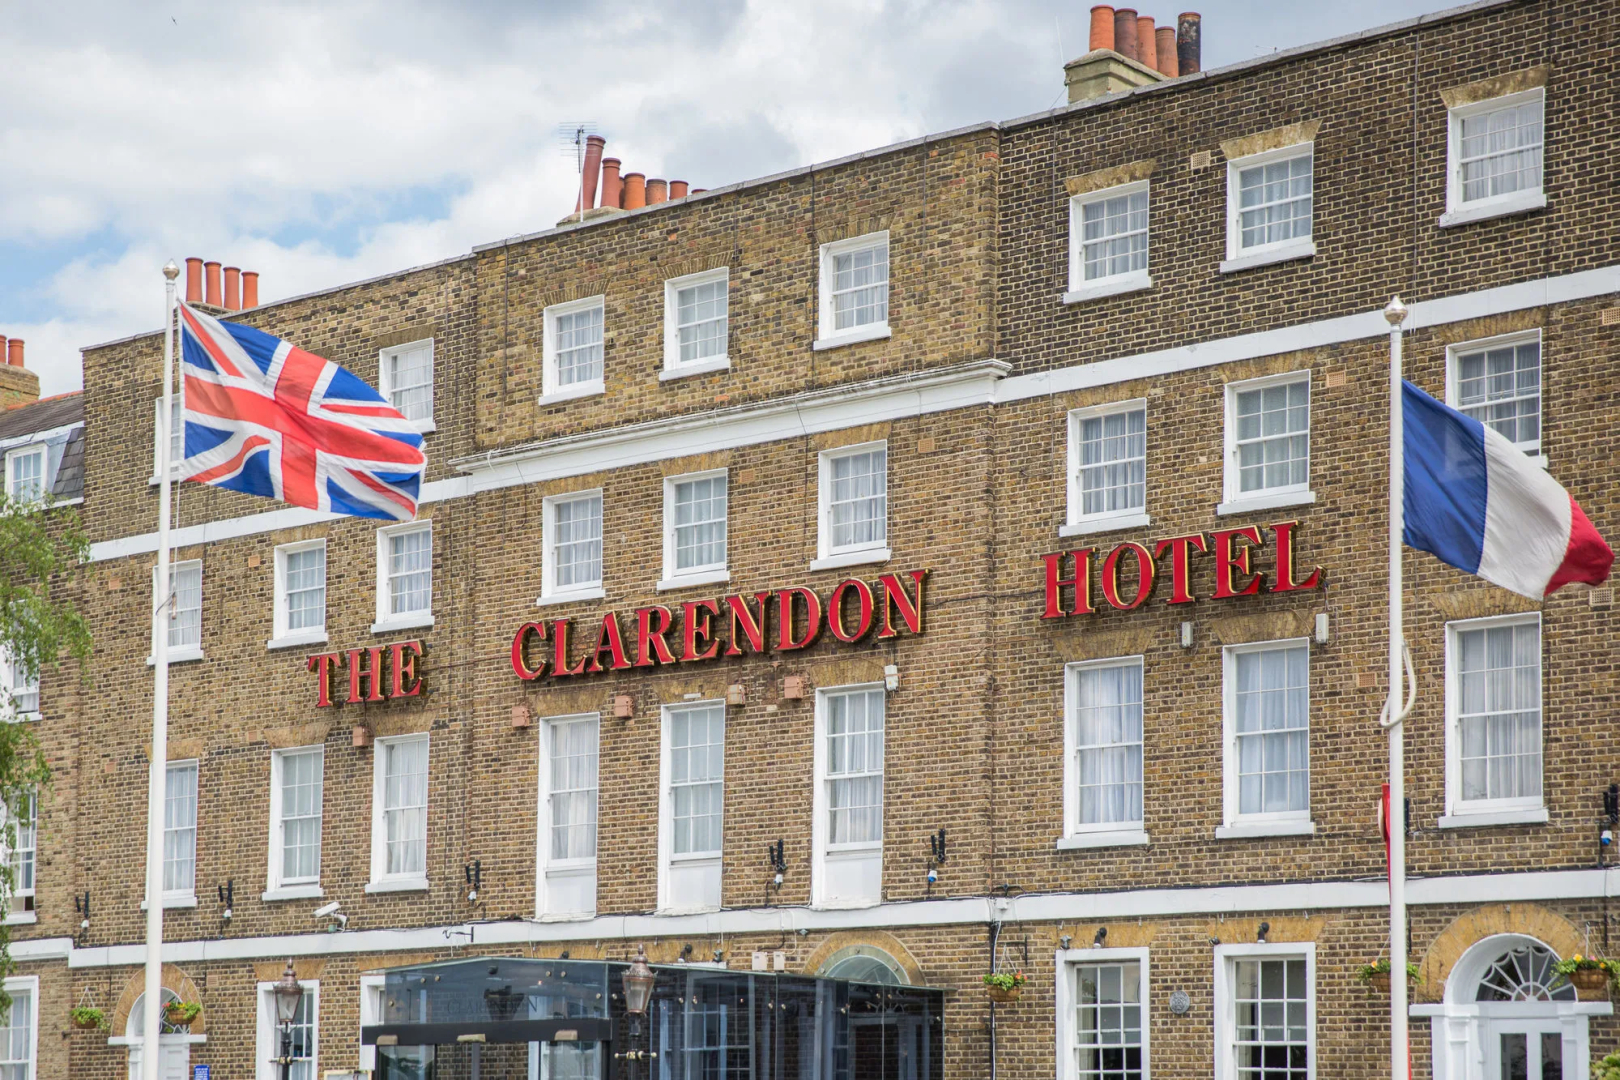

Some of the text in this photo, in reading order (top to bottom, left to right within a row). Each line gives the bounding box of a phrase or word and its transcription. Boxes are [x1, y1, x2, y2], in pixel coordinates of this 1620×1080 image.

[307, 519, 1325, 707] THE CLARENDON HOTEL
